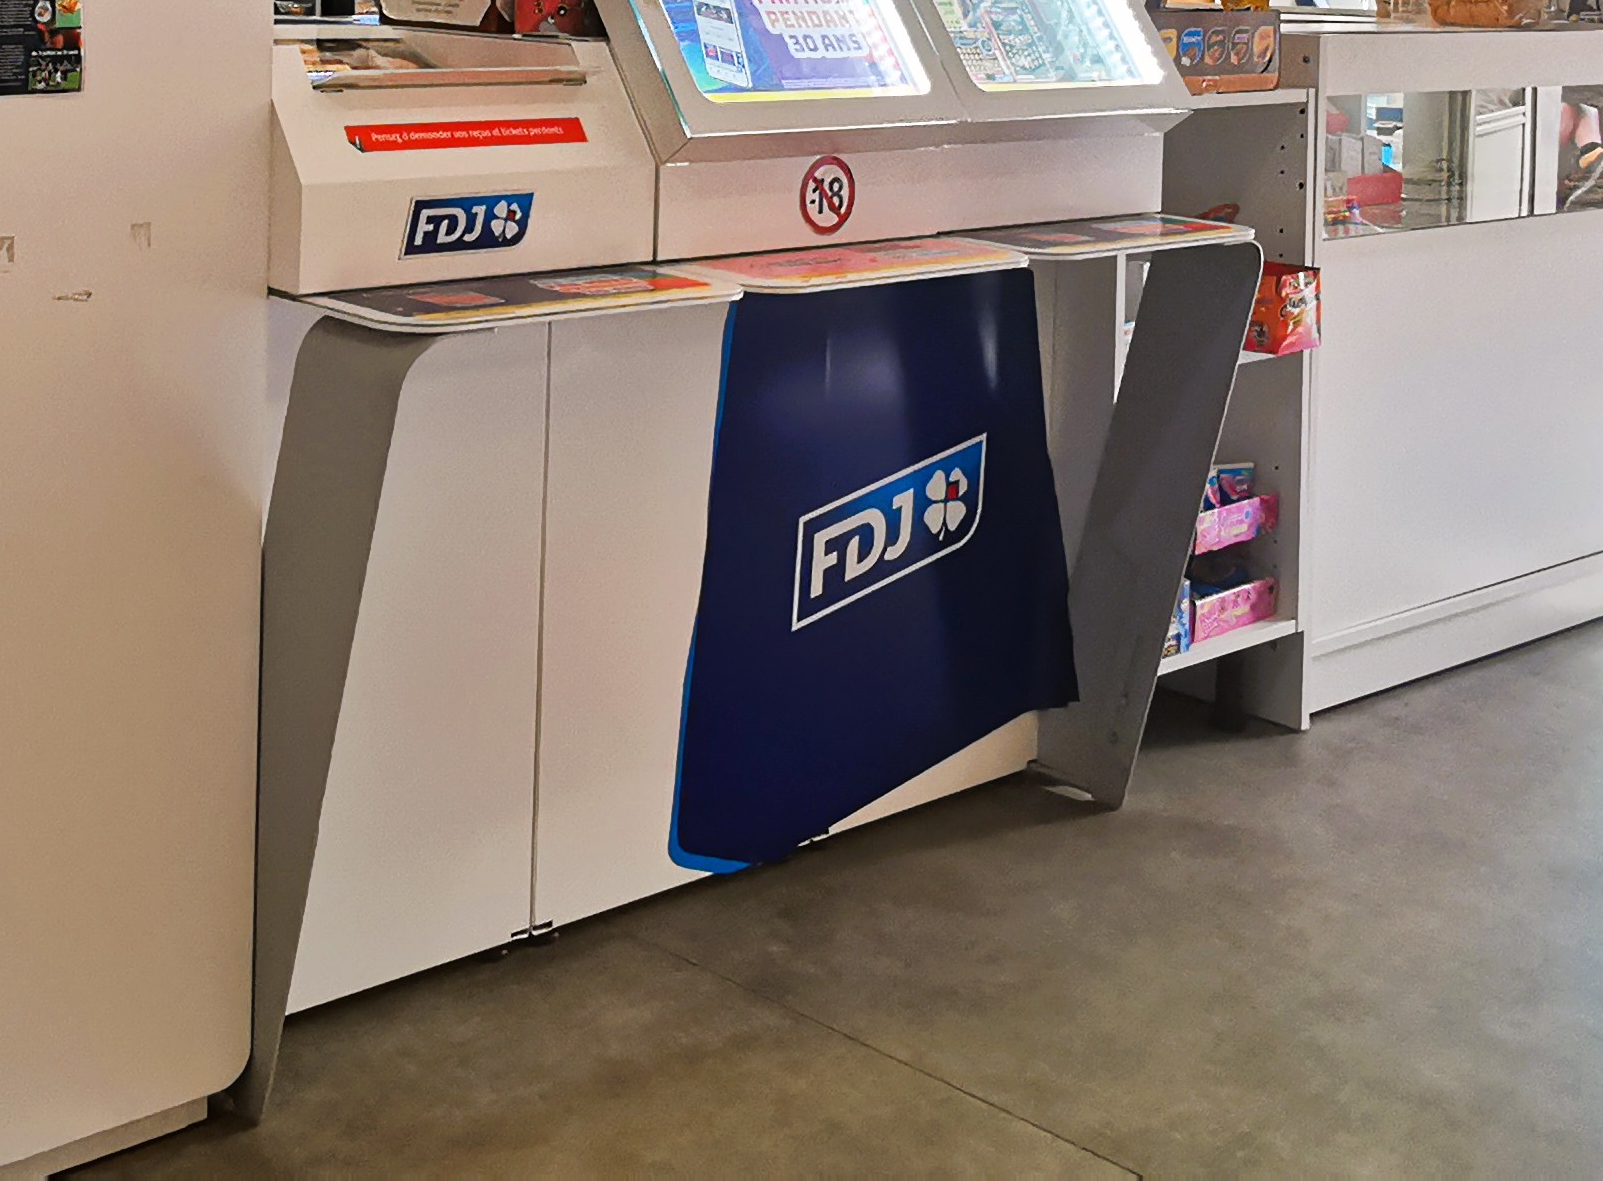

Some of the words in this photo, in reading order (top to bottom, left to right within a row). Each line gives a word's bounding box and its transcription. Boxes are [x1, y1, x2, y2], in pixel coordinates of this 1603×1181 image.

[788, 35, 819, 53] 30
[822, 34, 862, 53] ANS
[371, 132, 402, 144] Pensez
[414, 204, 488, 245] FDJ
[810, 487, 914, 599] FDJ
